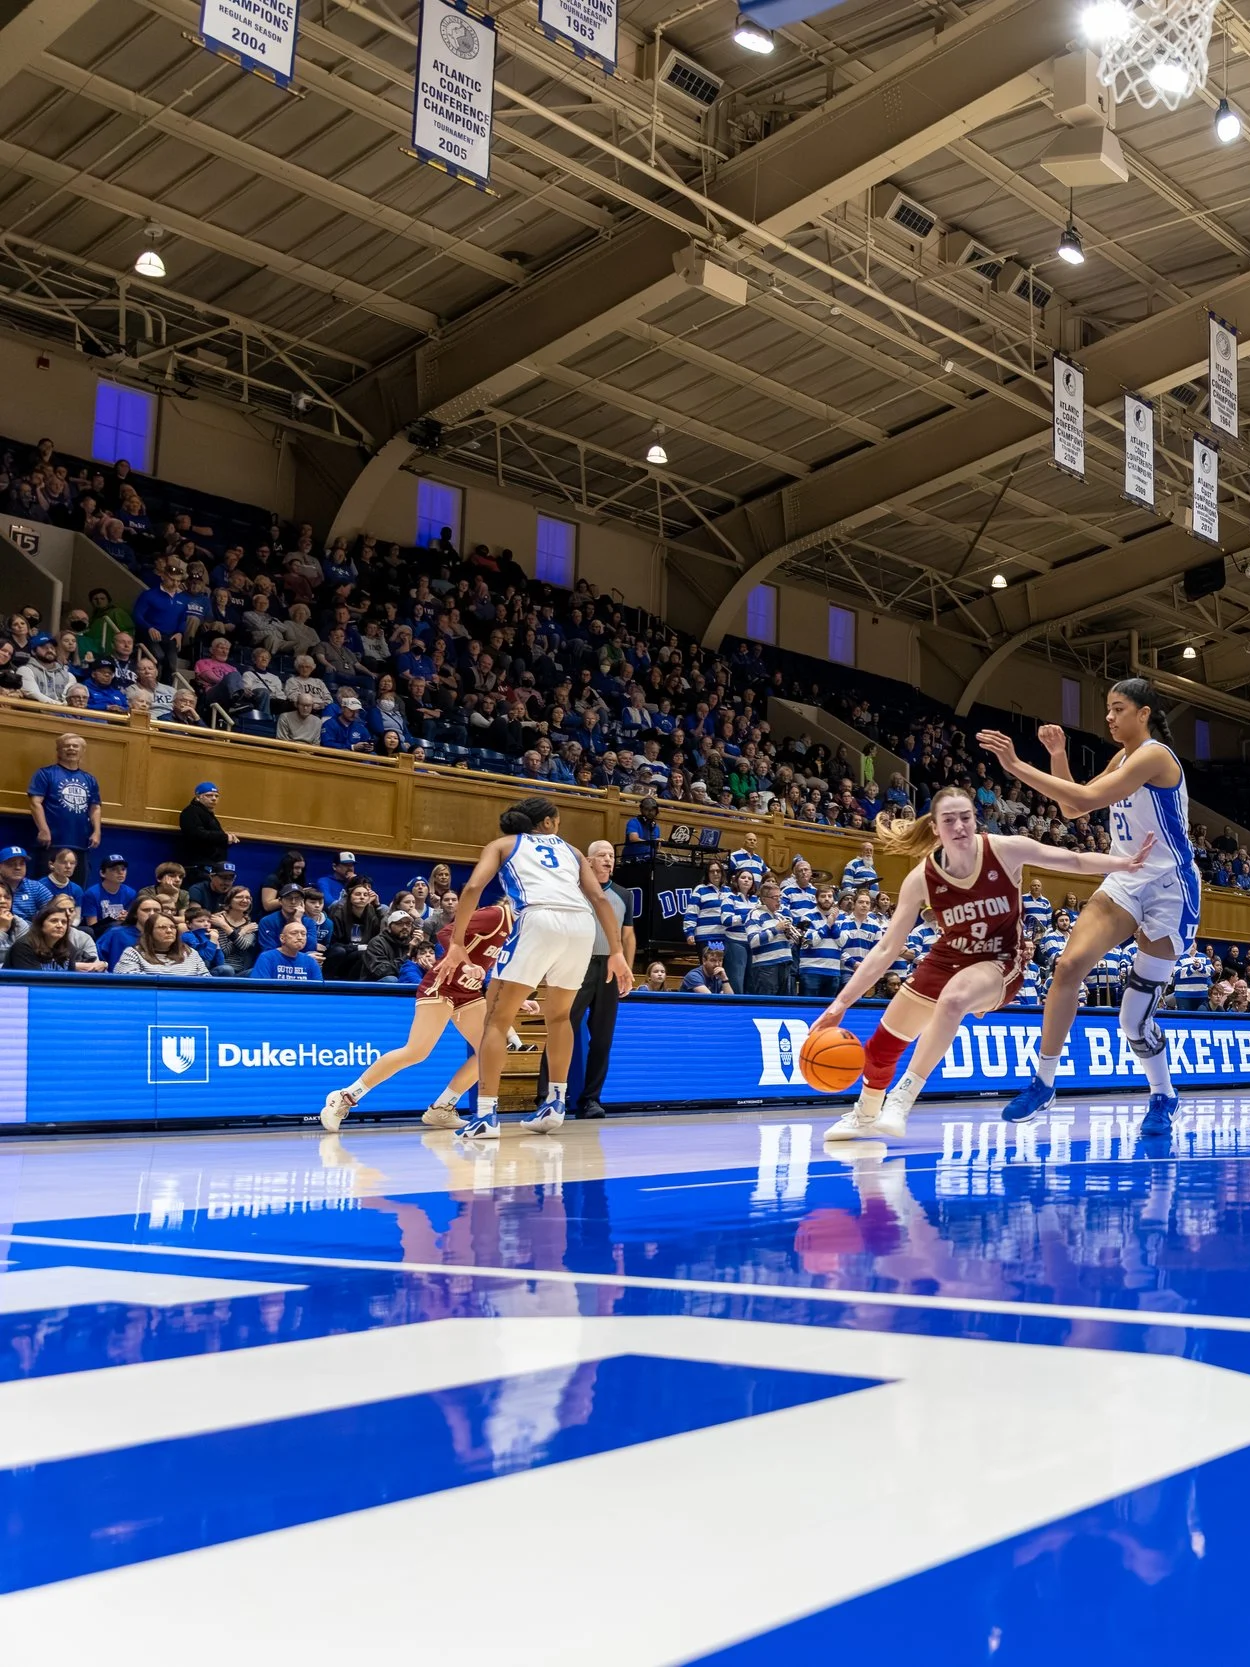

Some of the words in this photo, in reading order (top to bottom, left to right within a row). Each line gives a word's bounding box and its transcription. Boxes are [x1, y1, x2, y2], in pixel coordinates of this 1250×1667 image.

[219, 5, 252, 27] REGULAR
[254, 23, 282, 43] SEASON
[230, 0, 289, 32] AMPIONS
[560, 1, 601, 29] TOURNAMENT
[583, 6, 608, 24] SEASON
[566, 15, 595, 41] 1963
[231, 27, 266, 55] 2004
[433, 59, 482, 93] ATLANTIC
[440, 77, 473, 103] COAST
[421, 82, 490, 126] CONFERENCE
[423, 98, 487, 138] CHAMPIONS
[434, 119, 474, 146] TOURNAMENT
[438, 137, 468, 160] 2005
[1214, 362, 1233, 381] ATLANTIC
[1217, 374, 1231, 388] COAST
[1212, 379, 1237, 402] CONFERENCE
[1212, 389, 1236, 411] CHAMPIONS
[1060, 400, 1079, 418] ATLANTIC
[1062, 412, 1077, 425] COAST
[1056, 417, 1084, 438] CONFERENCE
[1057, 427, 1083, 448] CHAMPIONS
[1130, 435, 1150, 452] ATLANTIC
[1126, 452, 1153, 472] CONFERENCE
[16, 532, 36, 551] 15
[114, 667, 138, 683] UKE
[1113, 812, 1132, 841] 21
[536, 845, 560, 869] 3
[657, 888, 692, 919] DU
[942, 896, 1010, 927] BOSTON
[970, 922, 988, 939] 0
[950, 936, 1003, 955] OLLEGE
[941, 1025, 1076, 1078] DUKE
